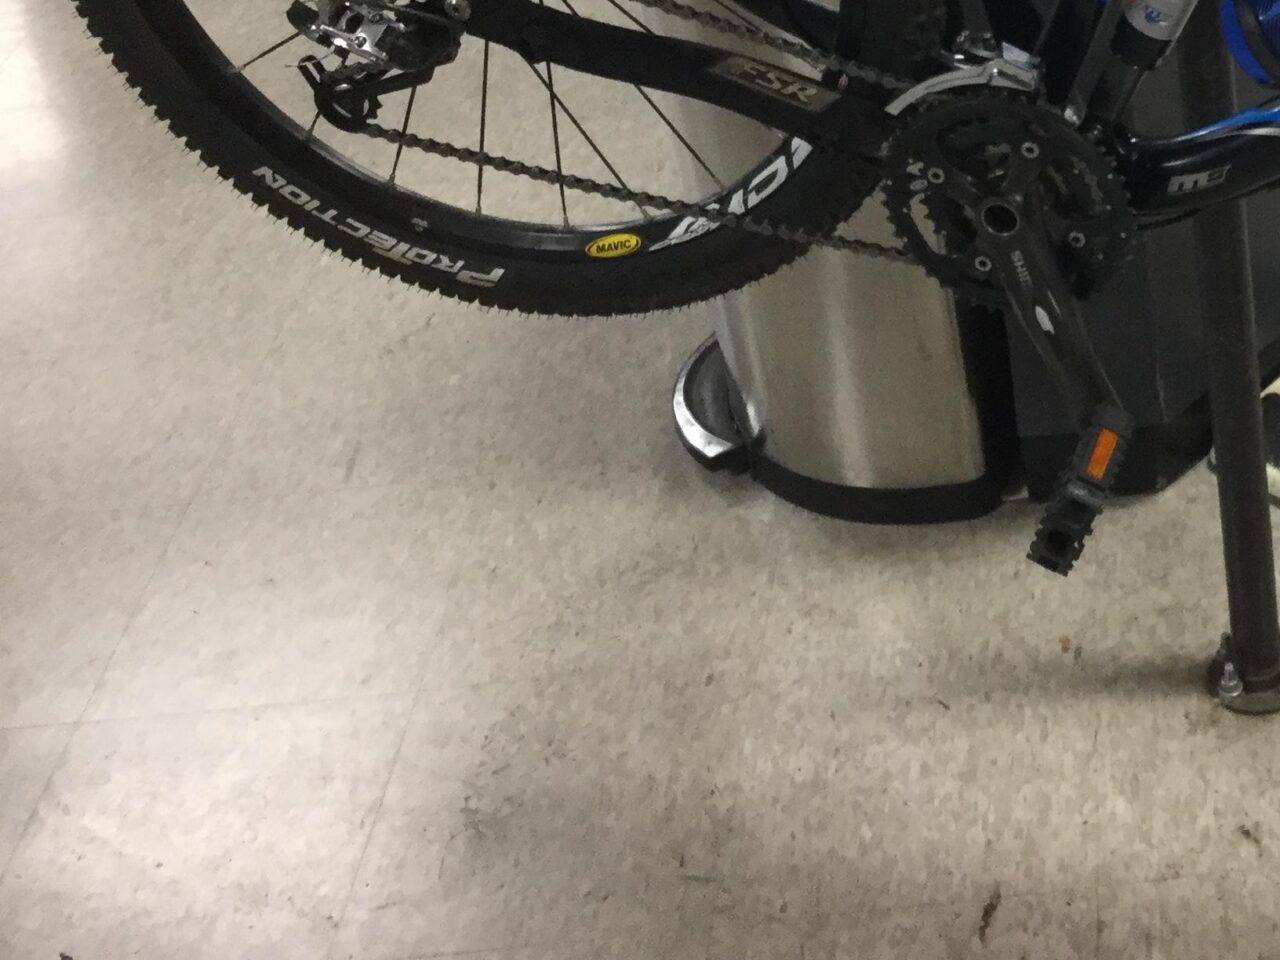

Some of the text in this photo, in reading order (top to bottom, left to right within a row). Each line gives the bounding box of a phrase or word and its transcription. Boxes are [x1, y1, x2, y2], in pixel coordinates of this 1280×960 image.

[742, 62, 819, 102] FSR
[252, 166, 505, 288] PROTECTION
[595, 238, 633, 255] MAVIC
